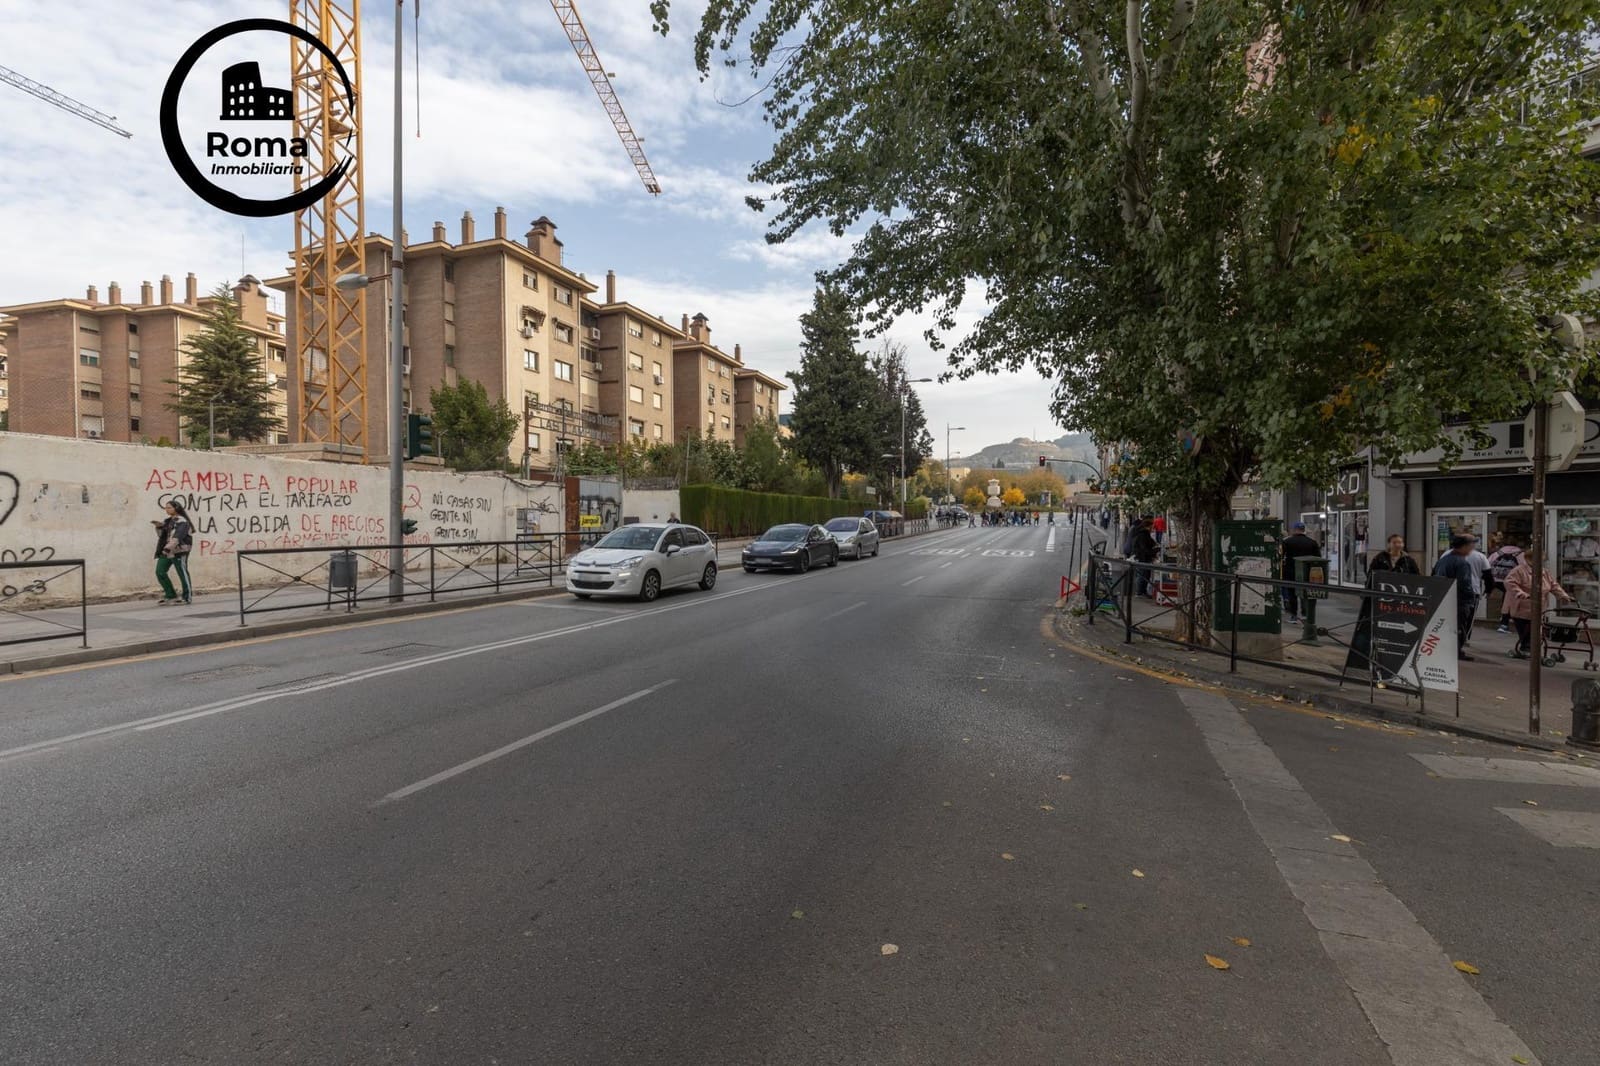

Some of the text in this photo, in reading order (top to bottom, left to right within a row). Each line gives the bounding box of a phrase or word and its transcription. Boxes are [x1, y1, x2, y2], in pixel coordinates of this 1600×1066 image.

[146, 469, 358, 494] ASAMBLEA POPULAR
[158, 491, 351, 513] CONTRA EL TARIFAZO
[447, 495, 474, 509] CASAS
[477, 497, 492, 512] SIN
[199, 517, 218, 535] LA
[228, 514, 290, 534] SUBIDA
[301, 514, 321, 533] DE
[430, 508, 473, 525] GENTE NI
[434, 526, 461, 540] GENTE
[1420, 634, 1440, 656] SIN
